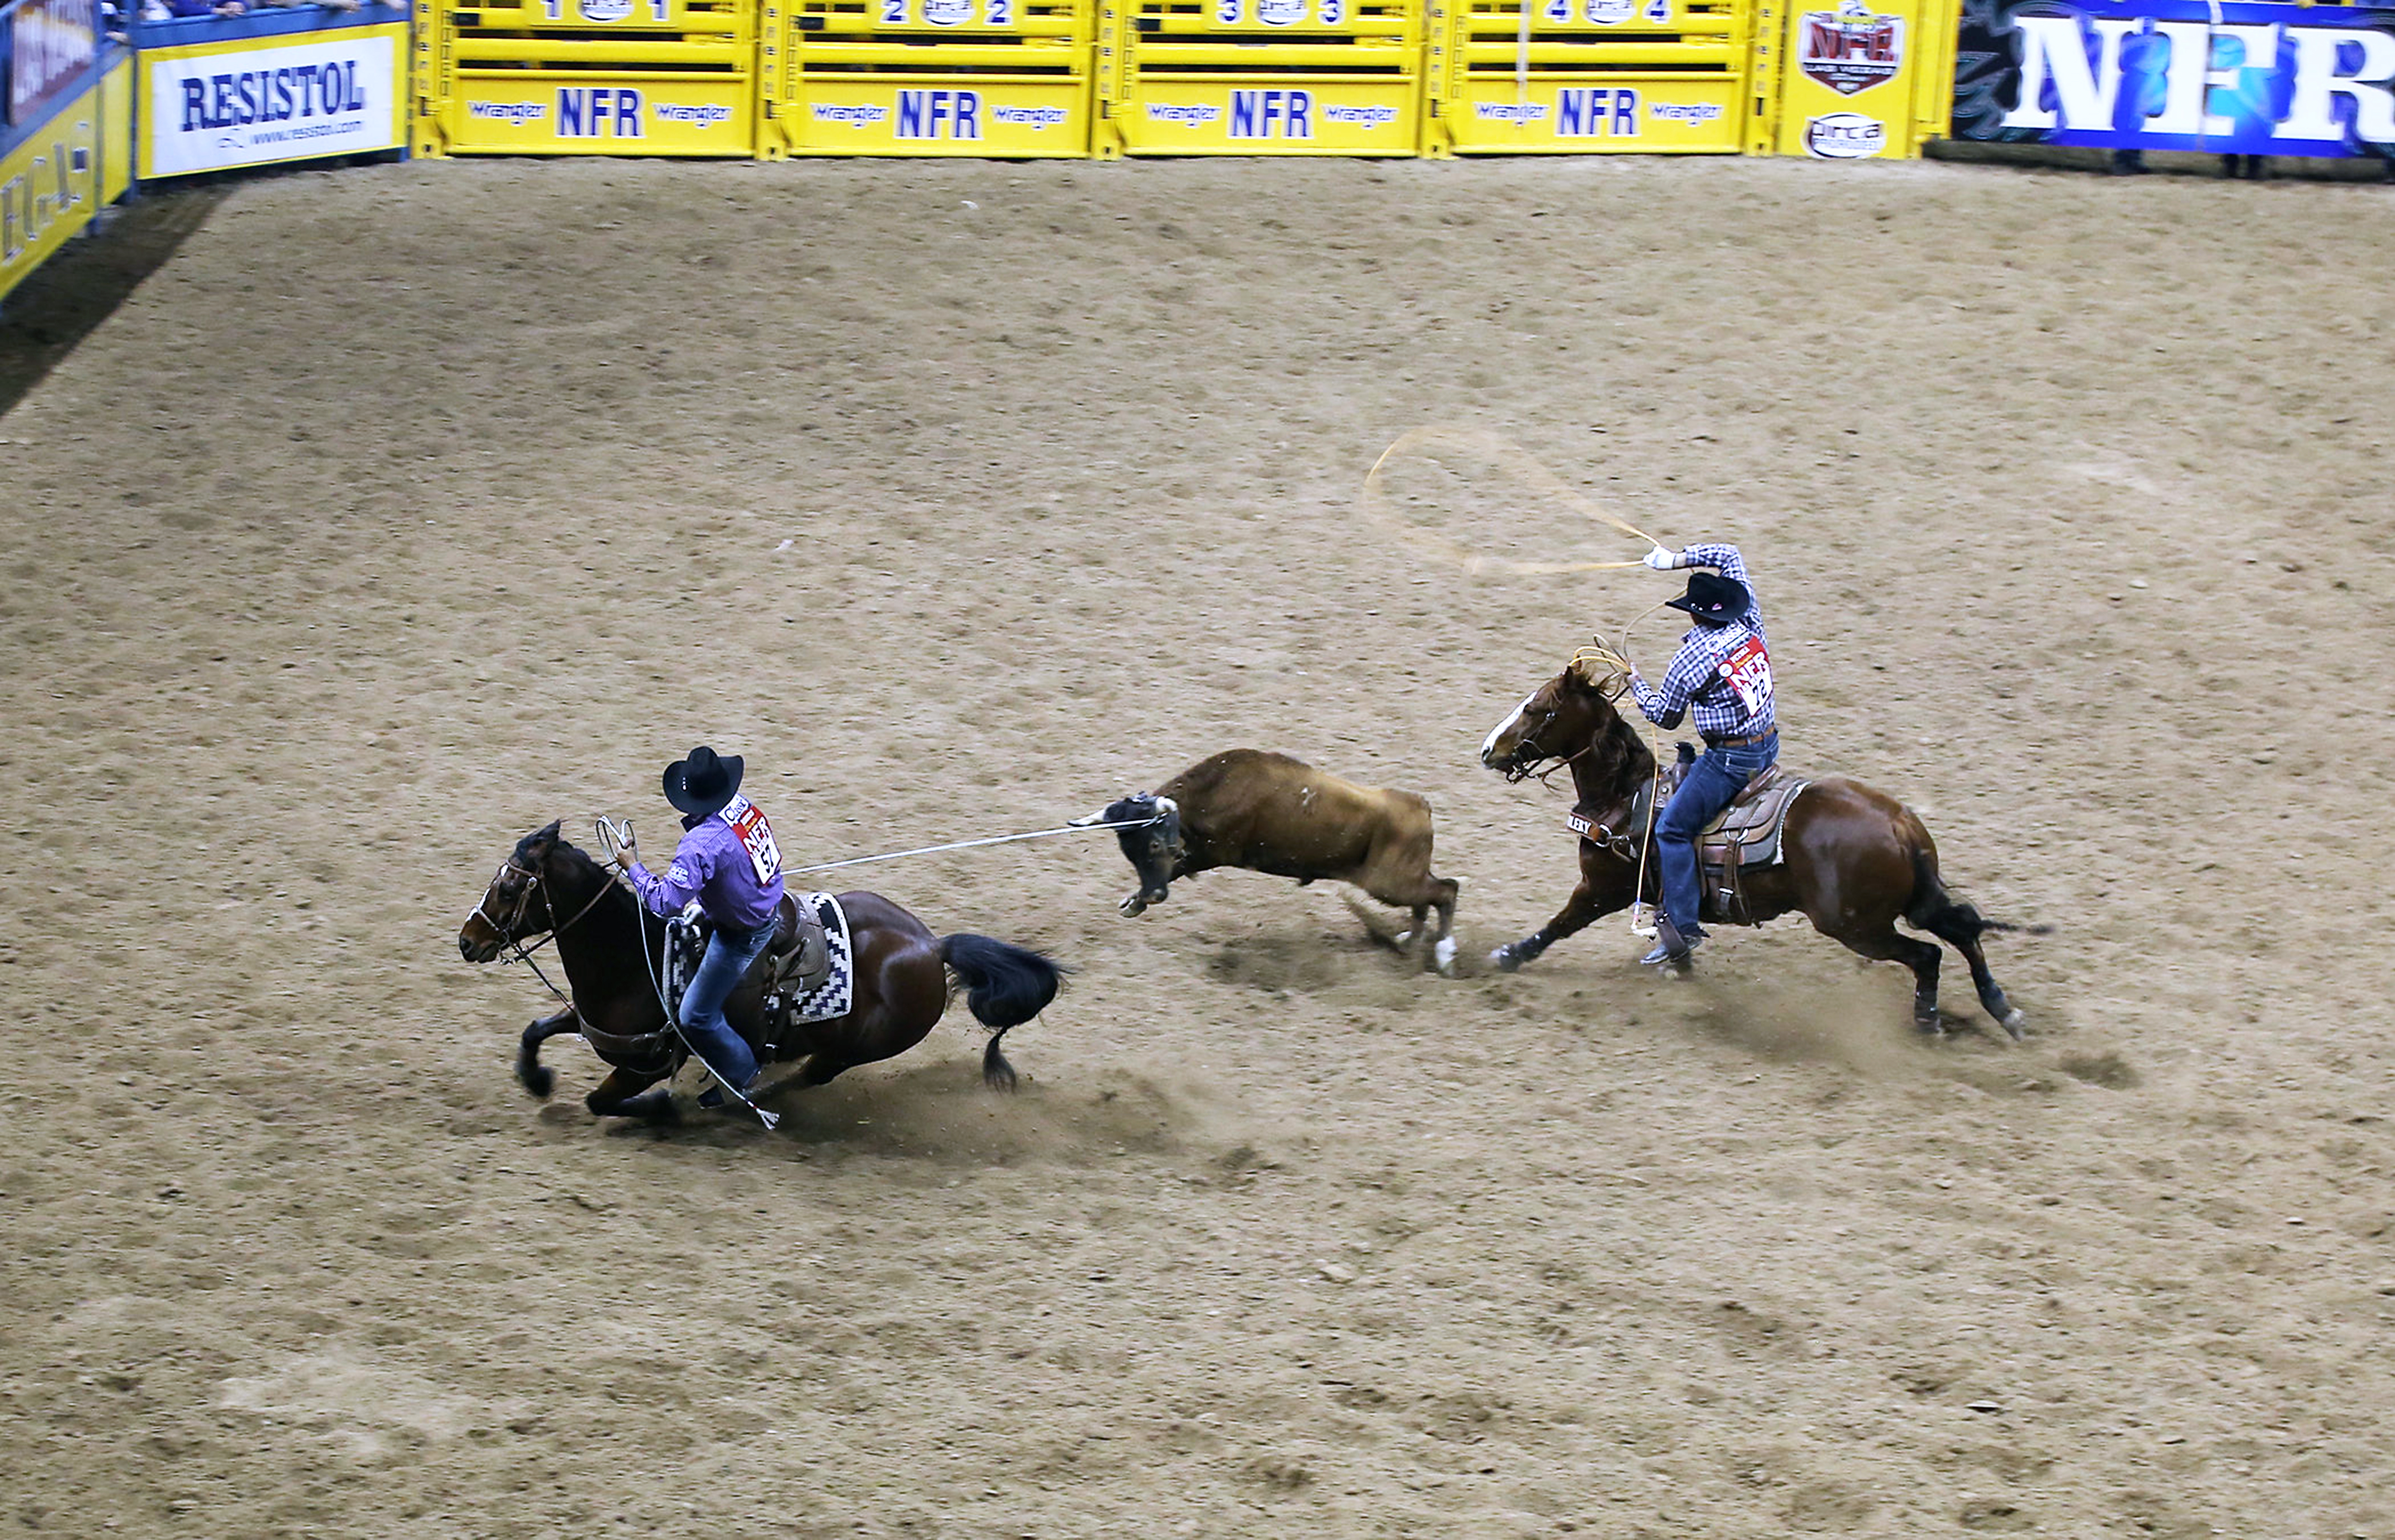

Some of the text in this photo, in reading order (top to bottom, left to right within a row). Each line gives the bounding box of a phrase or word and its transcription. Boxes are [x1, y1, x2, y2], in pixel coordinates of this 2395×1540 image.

[880, 0, 908, 23] 2
[984, 0, 1012, 25] 2
[1216, 0, 1244, 23] 3
[1317, 0, 1345, 25] 3
[1544, 0, 1572, 23] 4
[1643, 0, 1672, 23] 4
[1809, 22, 1894, 61] NFR
[180, 60, 366, 132] RESISTOL
[2001, 16, 2395, 143] NFR
[467, 87, 733, 138] Wrangler NFR Wrangler
[811, 89, 1067, 140] Wrangler NFR Wrangler
[1146, 89, 1400, 139] Wrangler NFR Wrangler
[1474, 88, 1724, 137] Wrangler NFR Wrangler
[1705, 624, 1747, 653] Classic
[1730, 652, 1767, 688] NFR
[1752, 679, 1767, 706] 72
[743, 816, 769, 853] NFR
[760, 844, 774, 873] 57
